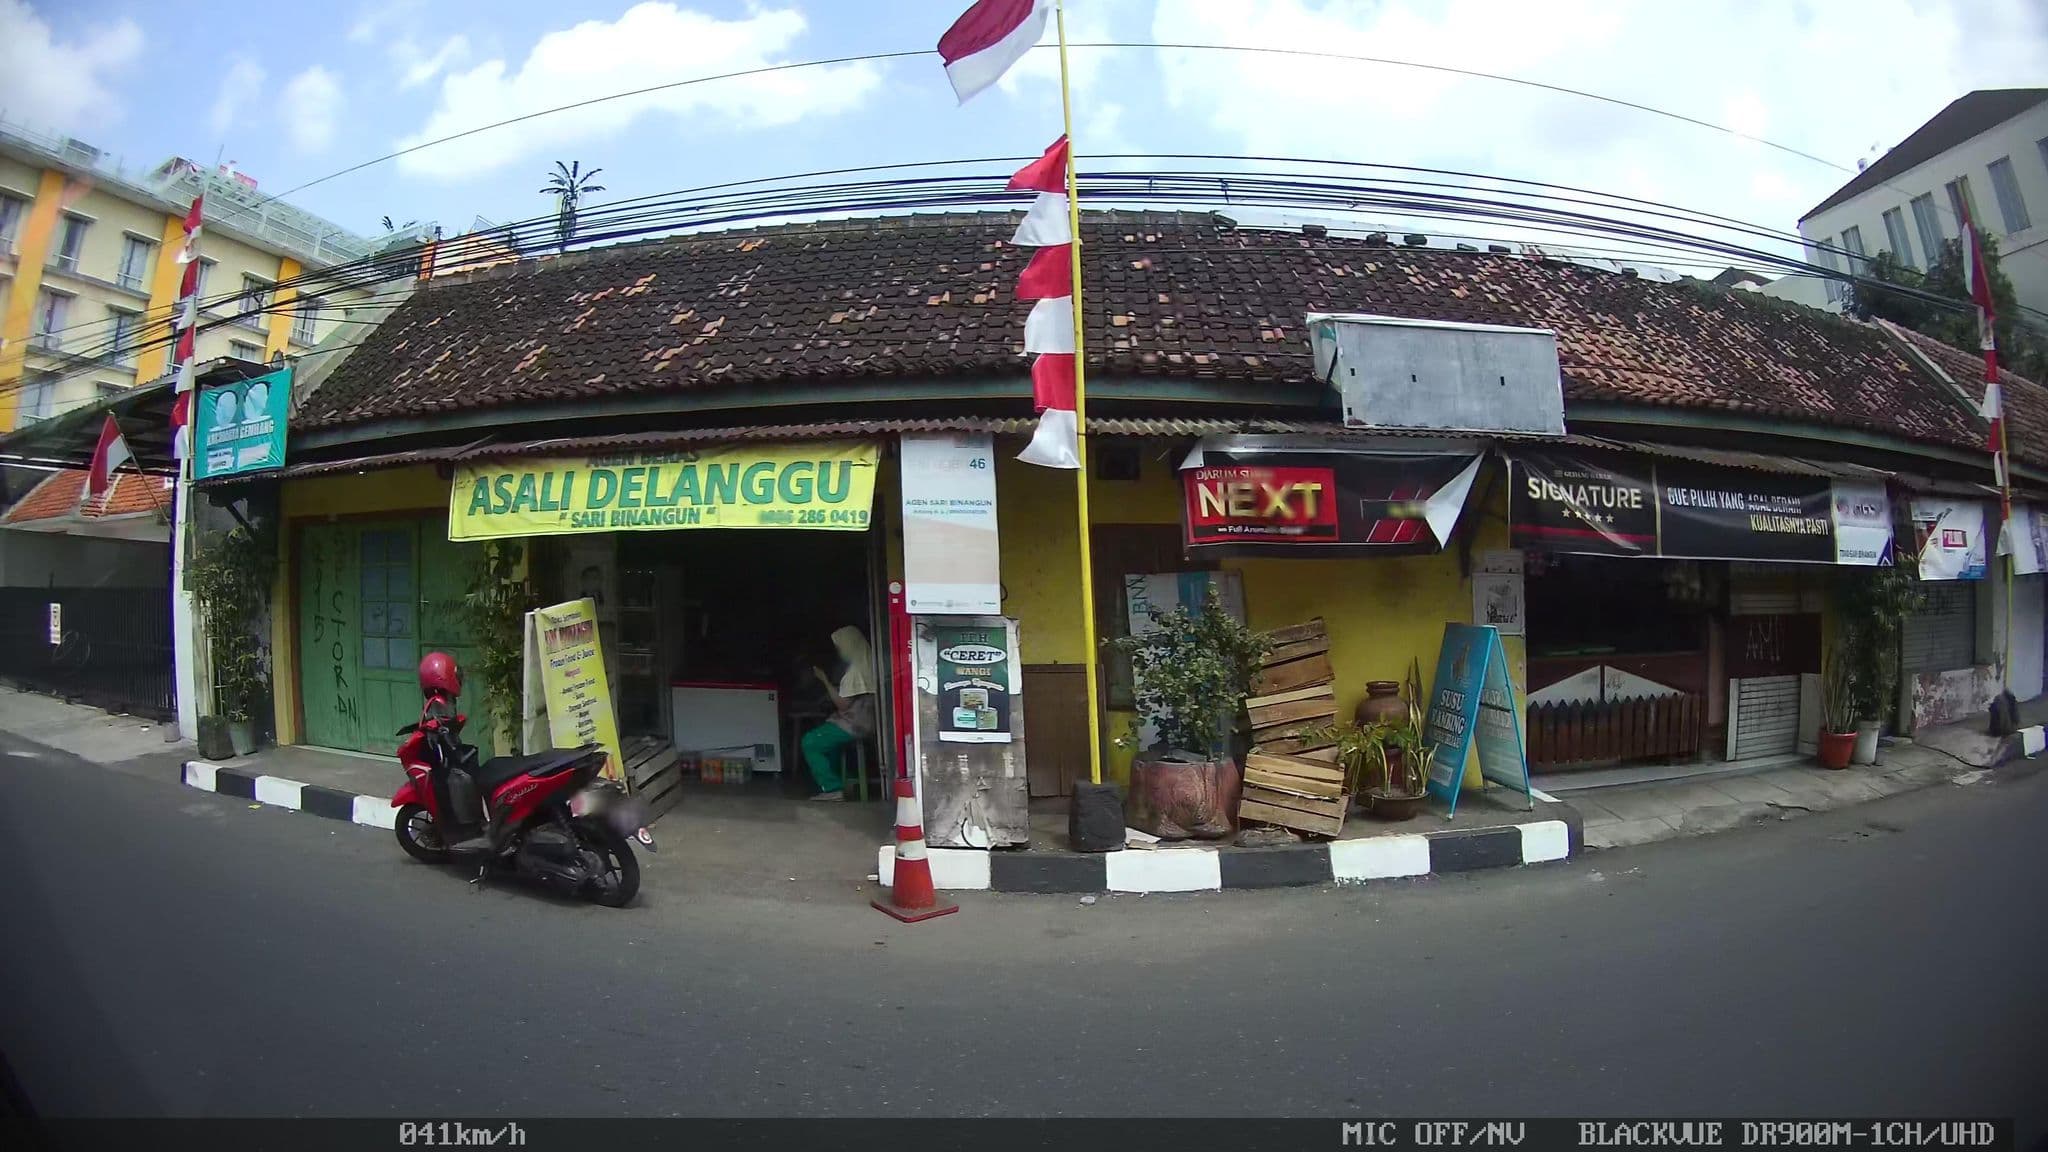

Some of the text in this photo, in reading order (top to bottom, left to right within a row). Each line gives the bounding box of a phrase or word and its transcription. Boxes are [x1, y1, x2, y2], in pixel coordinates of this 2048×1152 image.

[969, 458, 986, 469] 46
[1196, 470, 1237, 480] DJARUM
[468, 459, 853, 516] ASALI DELANGGU
[1528, 477, 1642, 509] SIGNATURE
[1197, 480, 1322, 519] NEXT
[1667, 487, 1689, 506] GUE
[1690, 488, 1718, 508] PILIH
[1718, 491, 1745, 510] YANG
[571, 508, 701, 528] SARI BINANGUN
[798, 510, 825, 523] 286
[830, 509, 868, 524] 0419
[1750, 514, 1829, 535] KUALITASNYA PASTI
[1228, 525, 1243, 533] Full
[1441, 689, 1465, 711] SUSU
